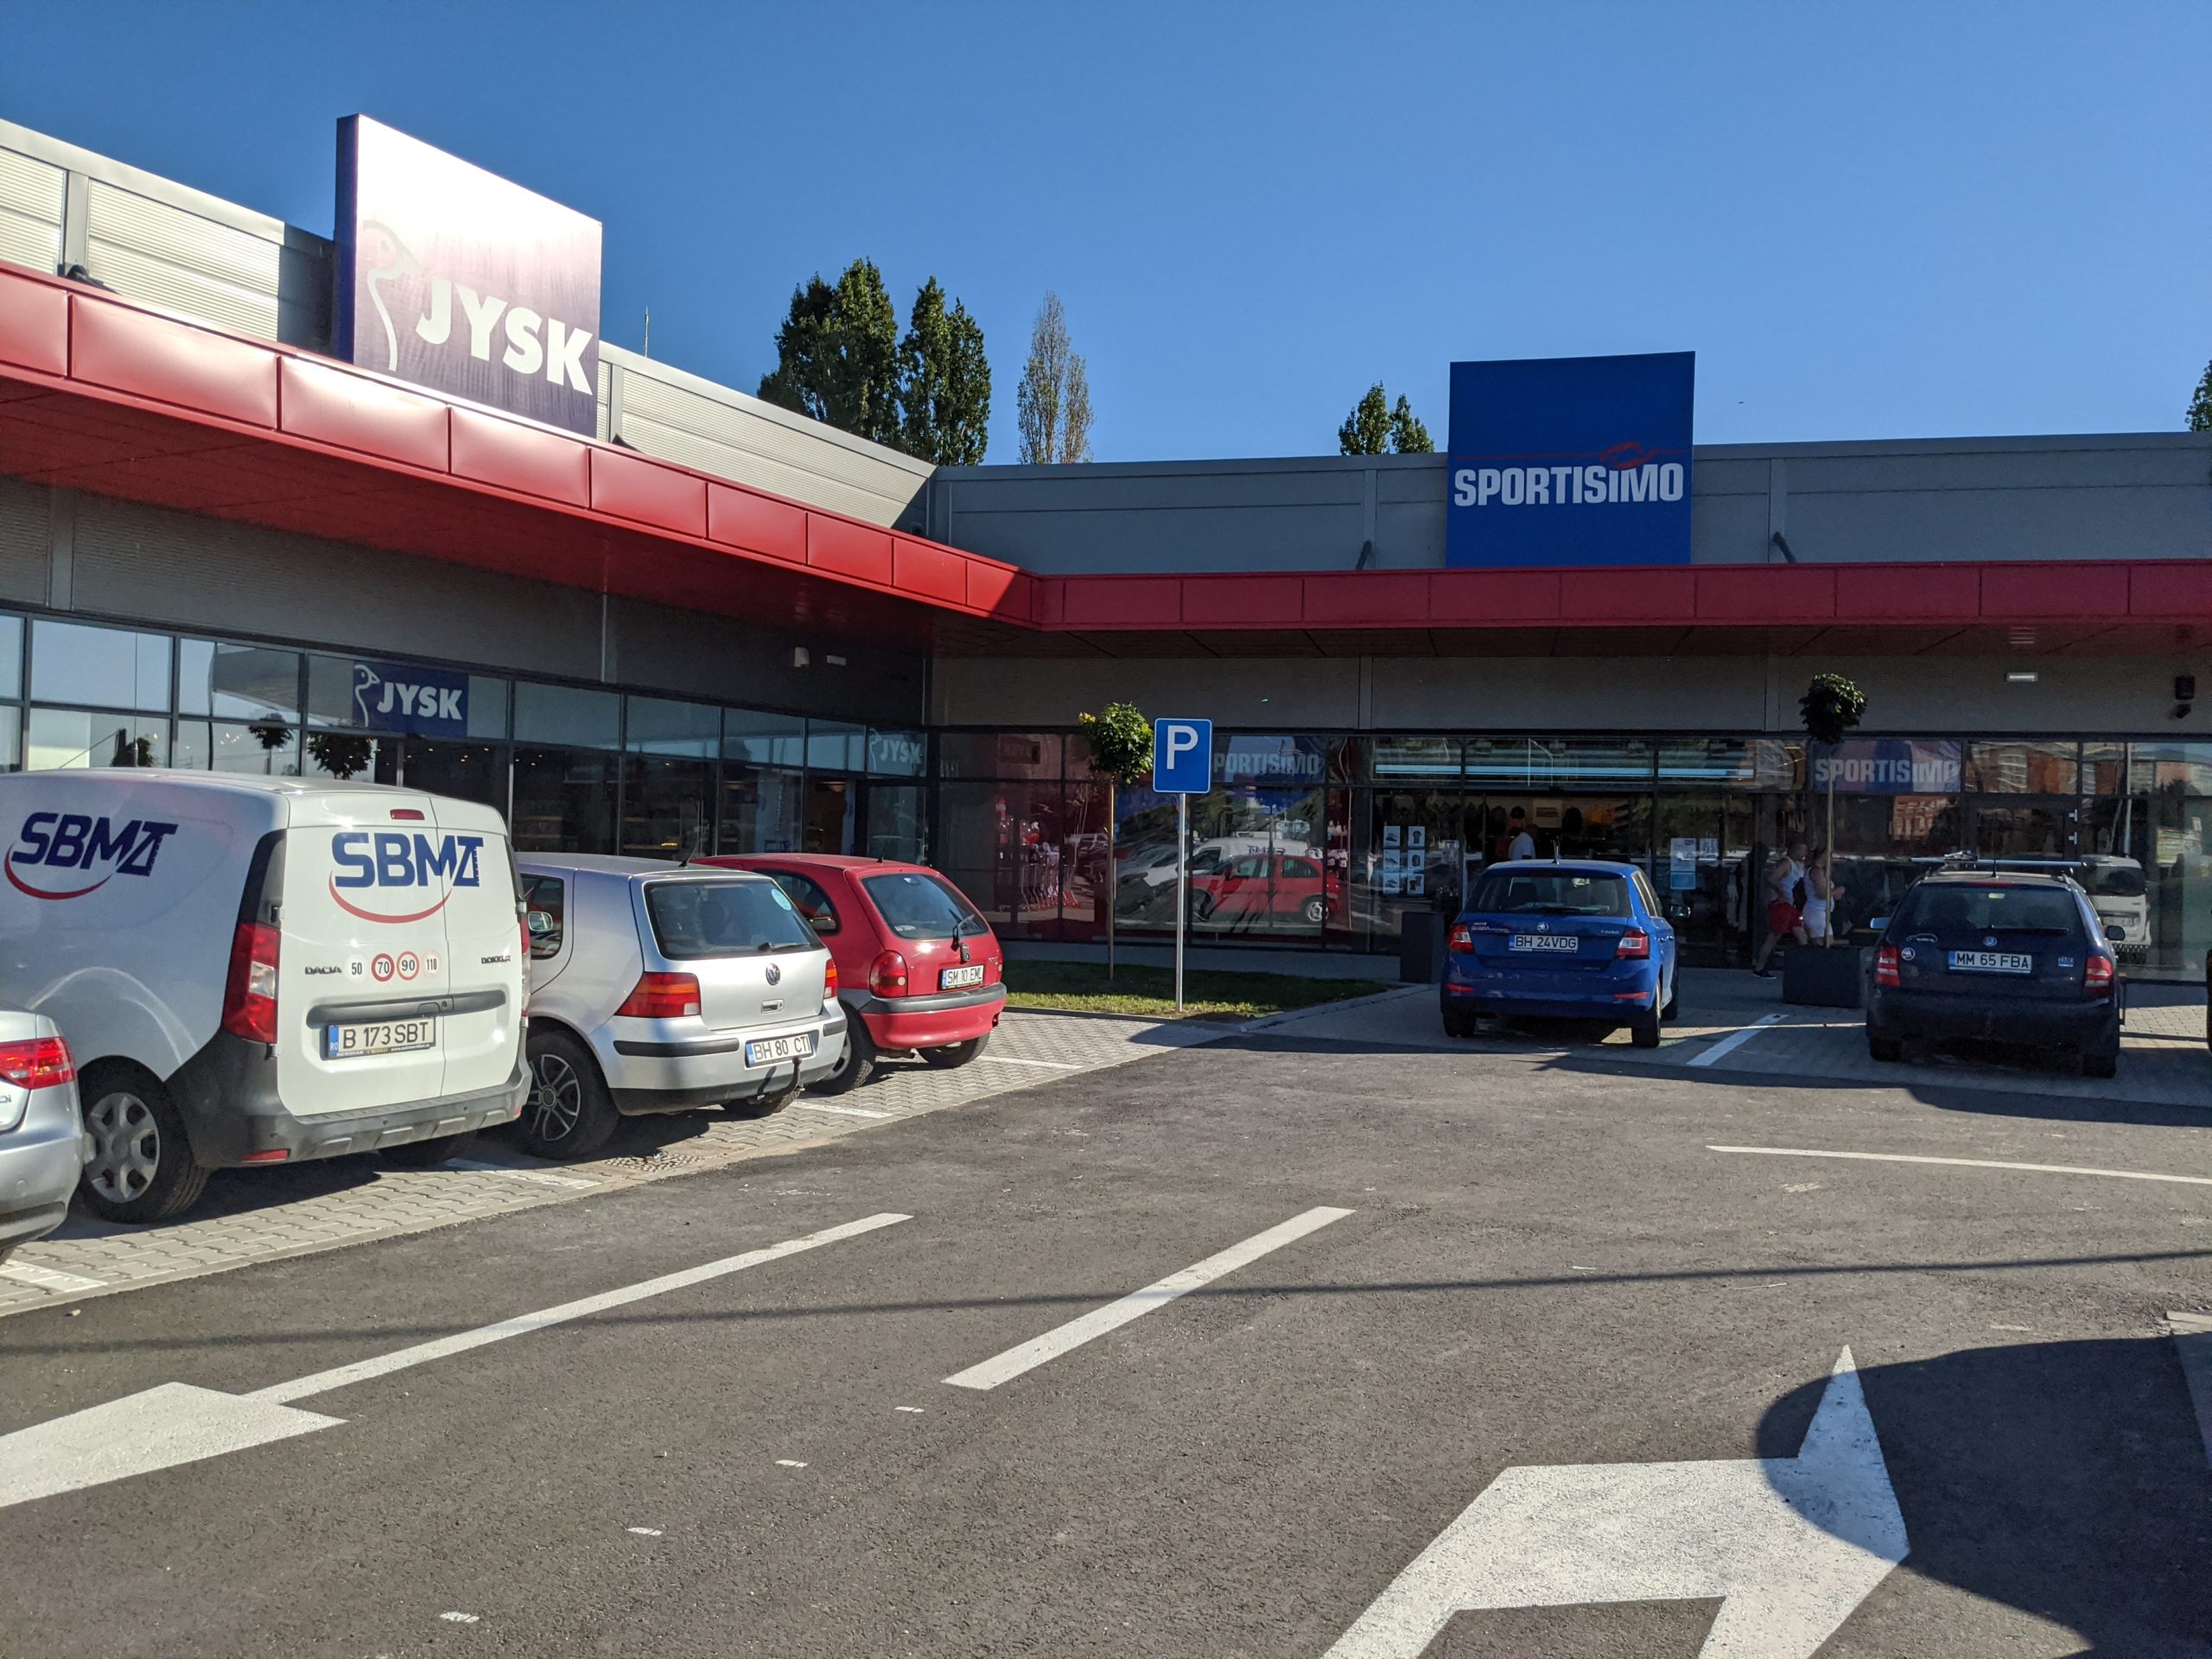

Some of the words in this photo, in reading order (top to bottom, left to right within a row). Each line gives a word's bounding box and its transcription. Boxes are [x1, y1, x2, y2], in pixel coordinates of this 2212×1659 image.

[416, 276, 594, 396] JYSK
[1454, 462, 1684, 507] SPORTISIMO
[377, 682, 463, 721] JYSK
[880, 740, 922, 765] JYSK
[1166, 725, 1198, 770] P
[1212, 752, 1320, 775] PORTISIMO
[1516, 936, 1533, 948] BH
[351, 962, 363, 976] 50
[377, 961, 391, 975] 70
[401, 959, 416, 972] 90
[426, 958, 438, 971] 110
[1956, 952, 1975, 965] MM
[1980, 953, 1996, 966] 65
[1999, 955, 2030, 969] FBA
[304, 966, 342, 976] DACIA
[947, 970, 959, 984] SM
[961, 969, 969, 982] 10
[969, 967, 982, 981] EML
[343, 1028, 357, 1049] B
[363, 1026, 391, 1047] 173
[394, 1021, 429, 1044] SBT
[329, 1042, 339, 1052] RO
[753, 1041, 773, 1061] BH
[774, 1039, 789, 1057] 80
